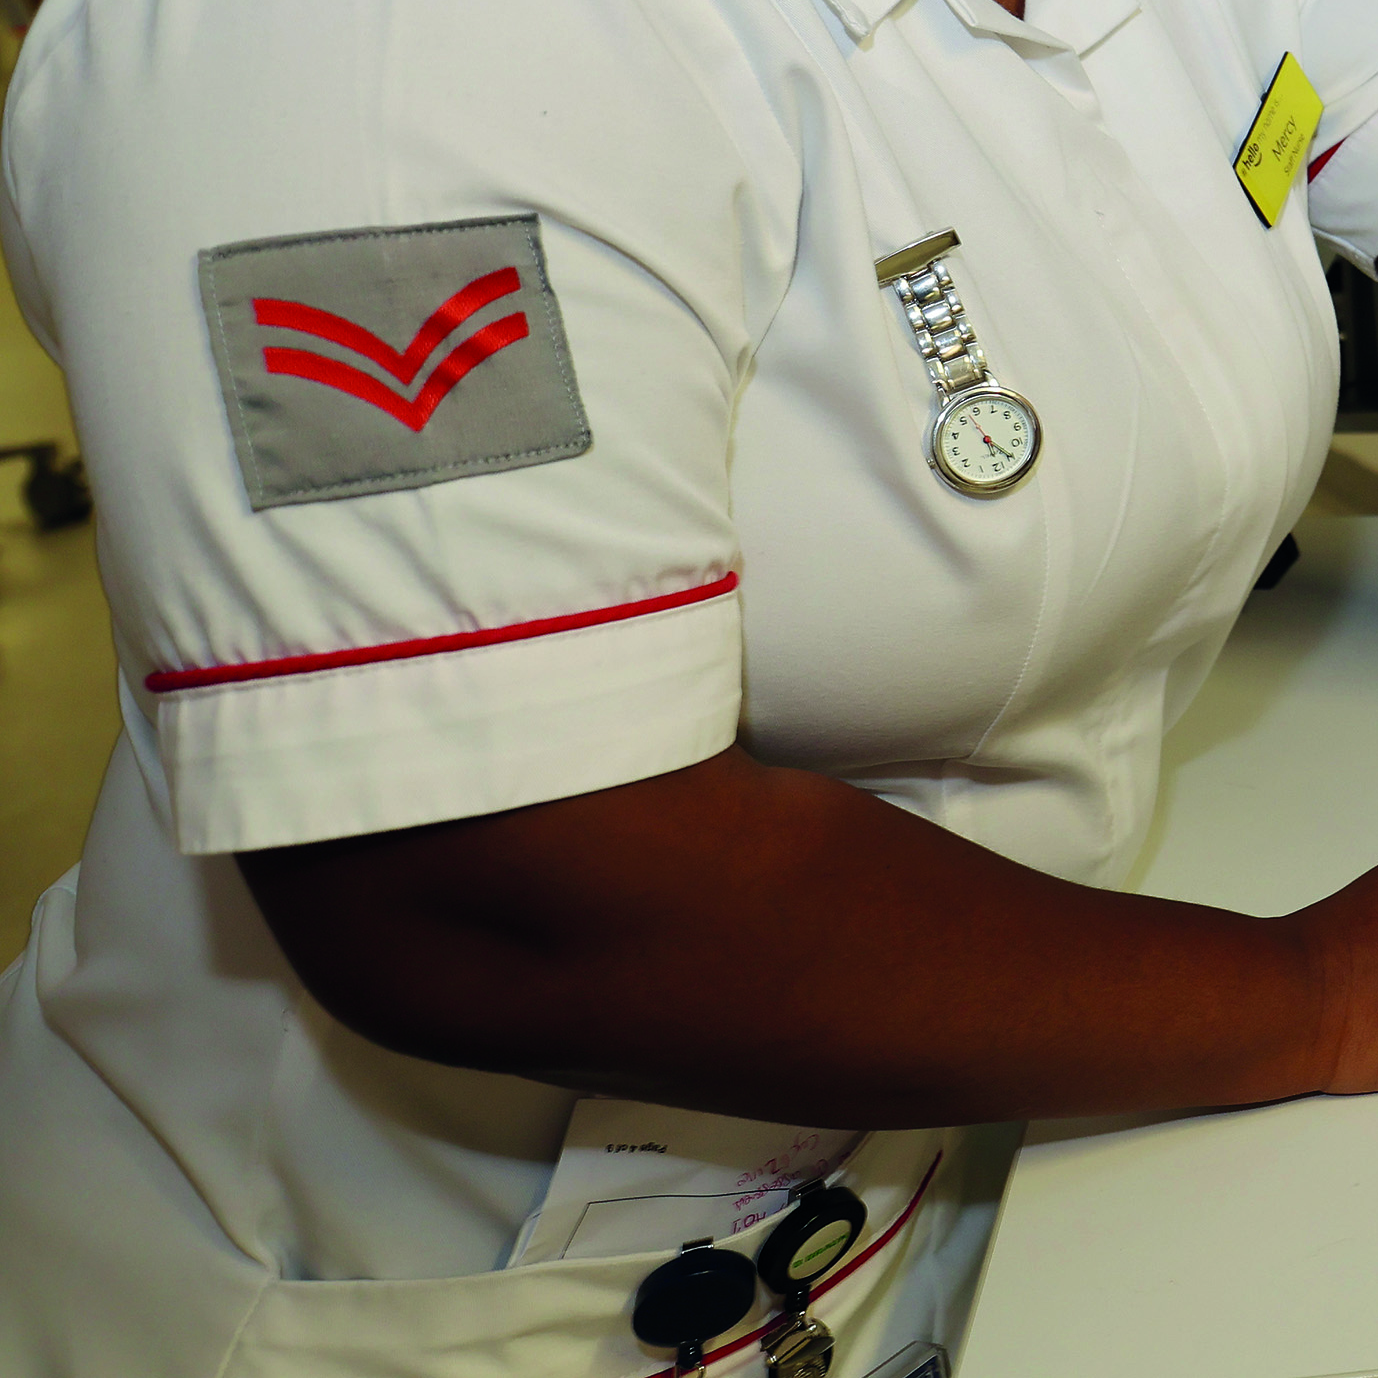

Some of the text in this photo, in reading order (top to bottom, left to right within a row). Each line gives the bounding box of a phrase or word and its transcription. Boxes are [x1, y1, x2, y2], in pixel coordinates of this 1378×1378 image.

[1271, 115, 1298, 162] Mercy
[1284, 154, 1297, 178] Staff
[972, 407, 981, 416] 6
[1003, 410, 1012, 420] 8
[959, 415, 968, 426] 5
[951, 432, 959, 440] 4
[1011, 437, 1024, 448] 10
[952, 446, 960, 456] 3
[961, 458, 971, 468] 2
[991, 461, 1006, 472] 12
[978, 465, 984, 473] 1
